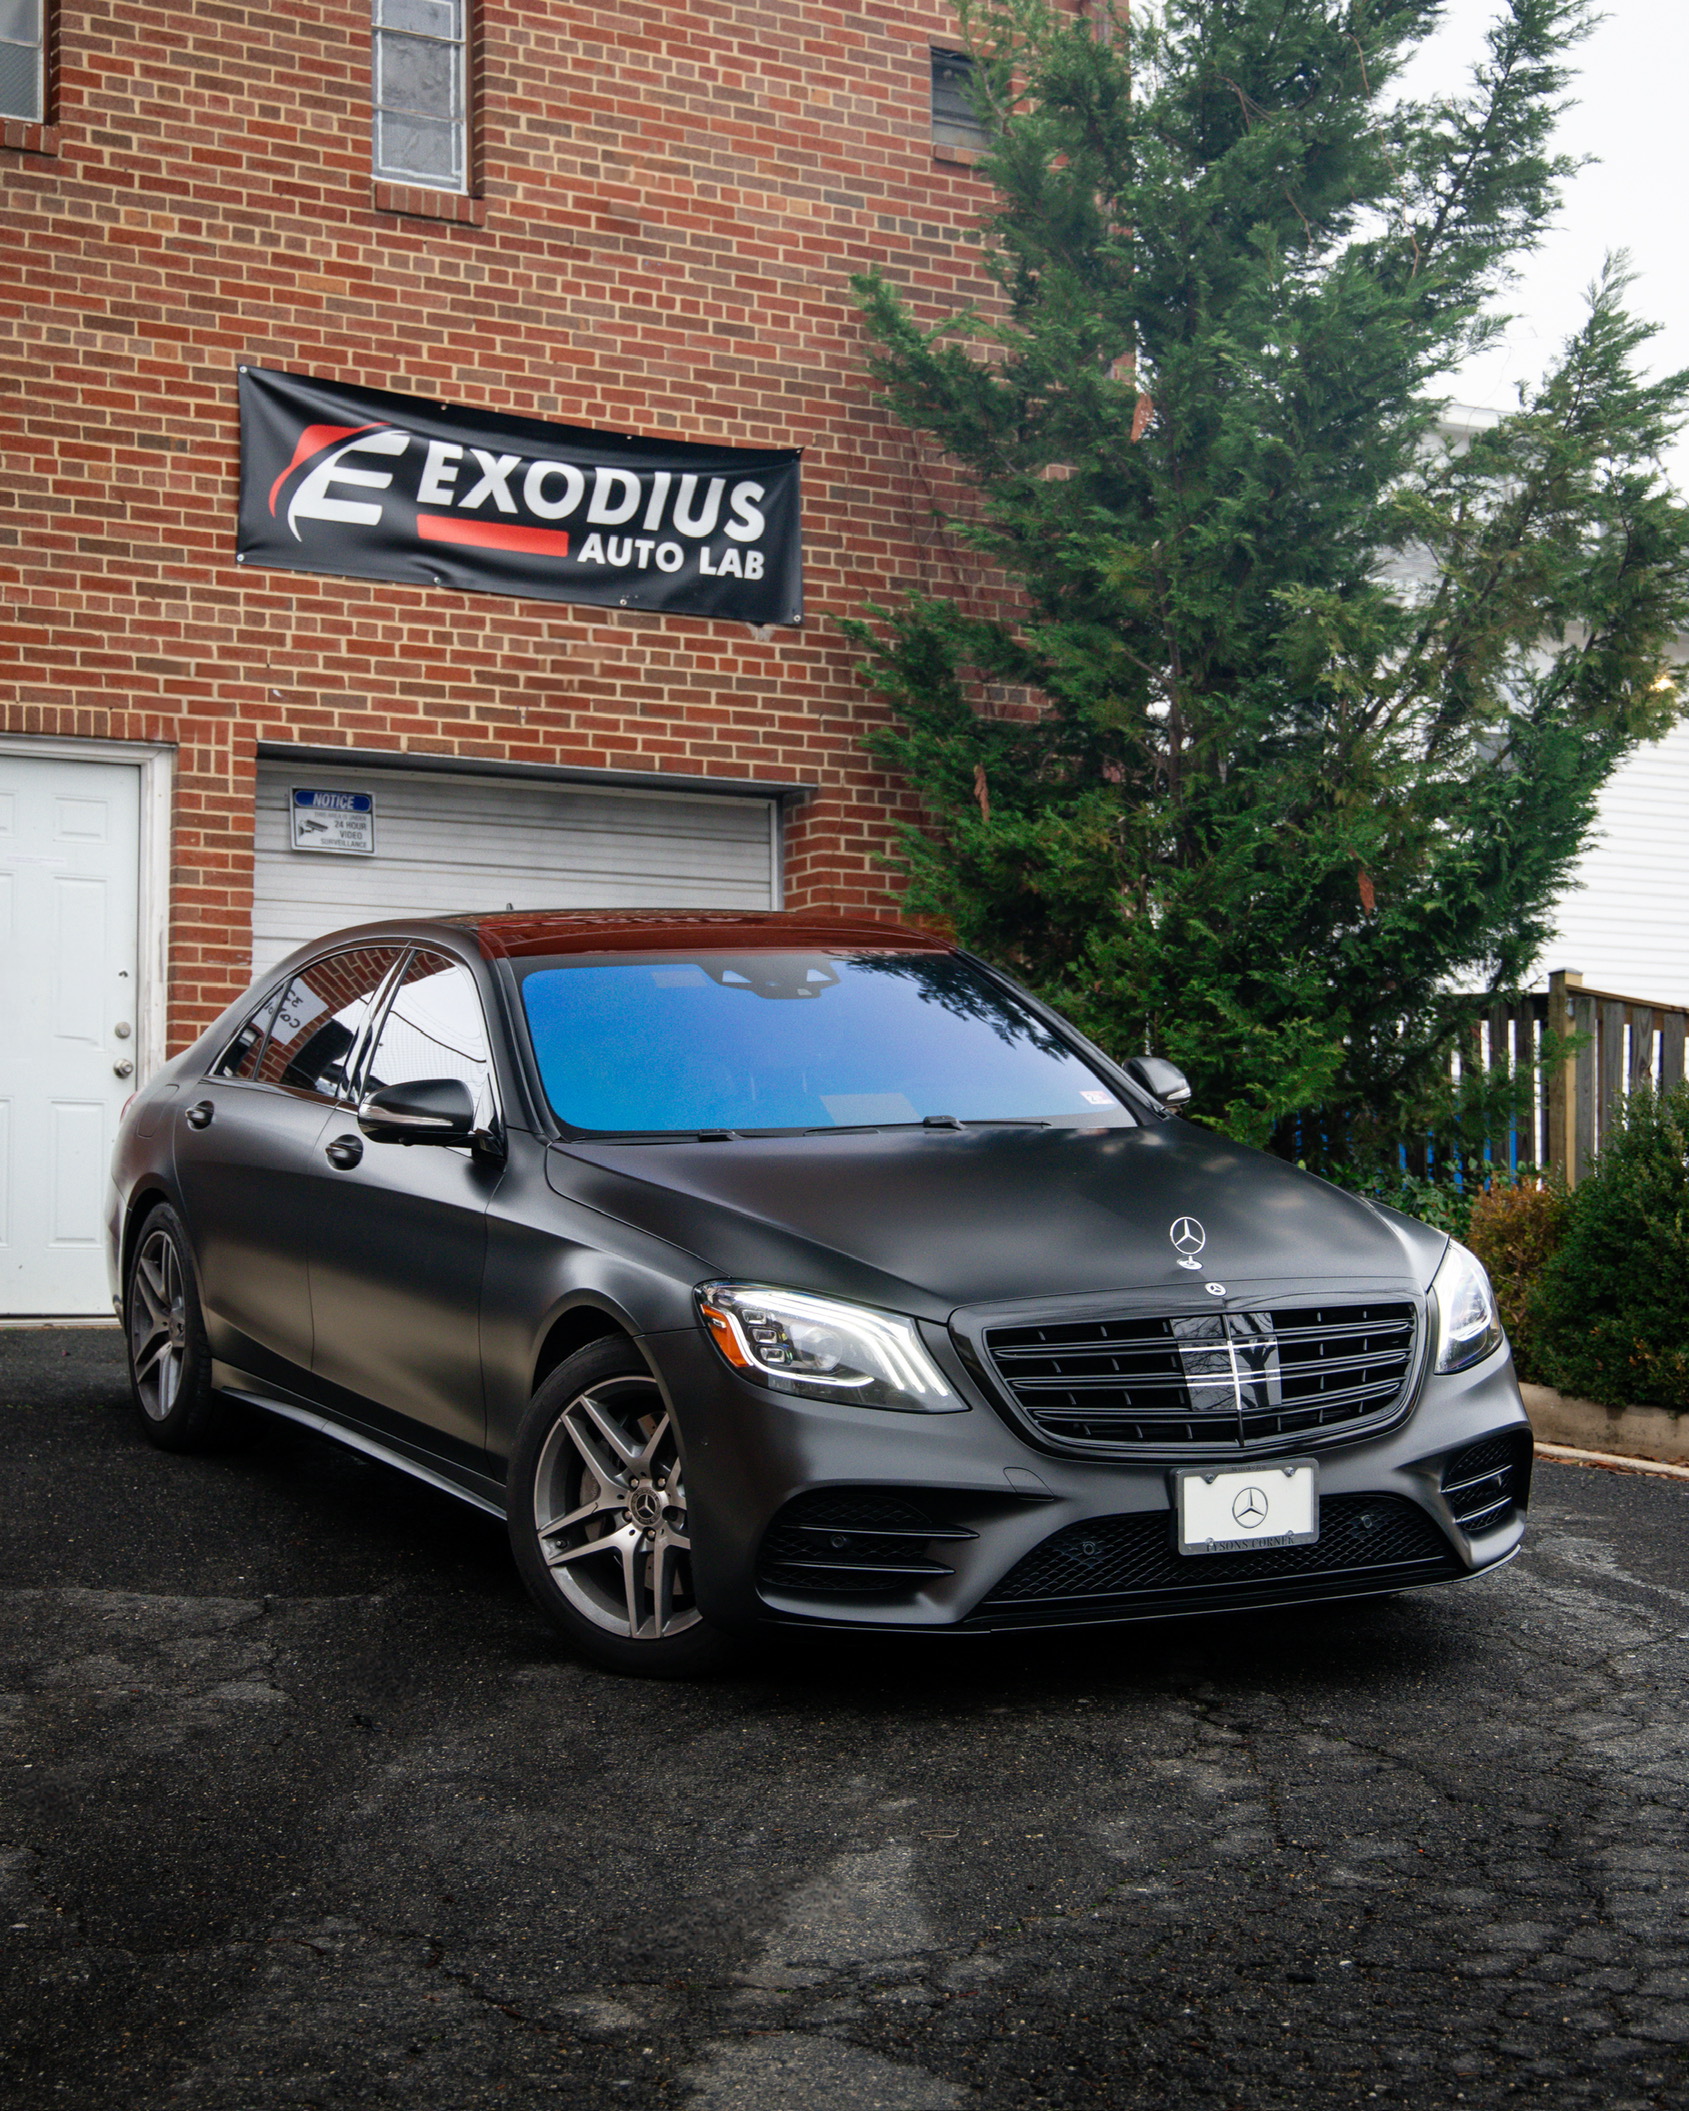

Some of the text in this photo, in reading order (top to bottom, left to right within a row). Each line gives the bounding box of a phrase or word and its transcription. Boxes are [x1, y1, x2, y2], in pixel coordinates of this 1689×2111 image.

[416, 438, 766, 543] EXODIUS
[577, 532, 765, 581] AUTO LAB
[312, 793, 355, 810] NOTICE
[334, 820, 367, 831] 24 HOUR
[339, 830, 363, 840] VIDEO
[321, 838, 367, 848] SURVEILLANCE
[1251, 1535, 1295, 1549] CORNER
